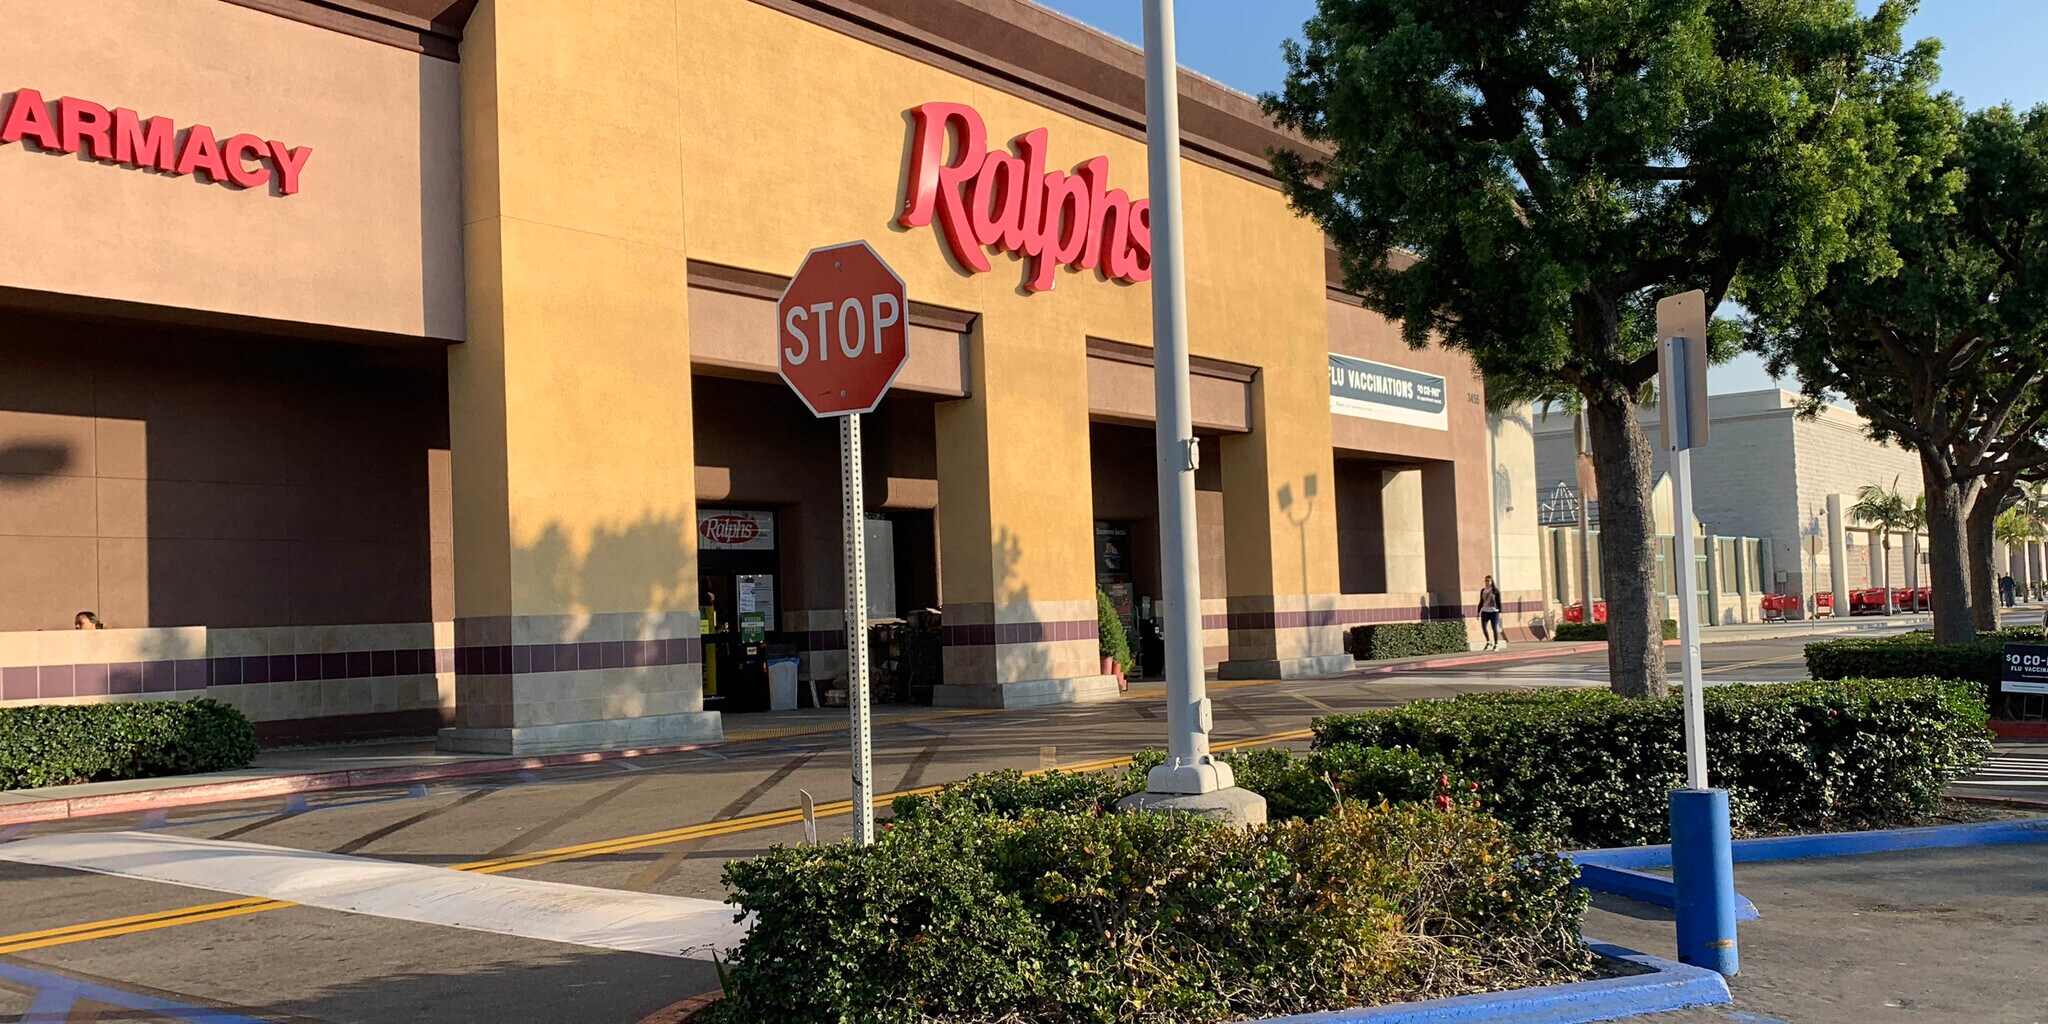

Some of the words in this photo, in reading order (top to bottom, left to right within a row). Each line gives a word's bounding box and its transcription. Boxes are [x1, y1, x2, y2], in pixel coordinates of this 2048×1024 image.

[0, 87, 313, 195] ARMACY
[897, 101, 1152, 292] Ralphs
[784, 293, 900, 366] STOP
[1348, 369, 1413, 399] VACCINATIONS
[706, 518, 753, 543] Ralphs
[2006, 654, 2020, 664] $0
